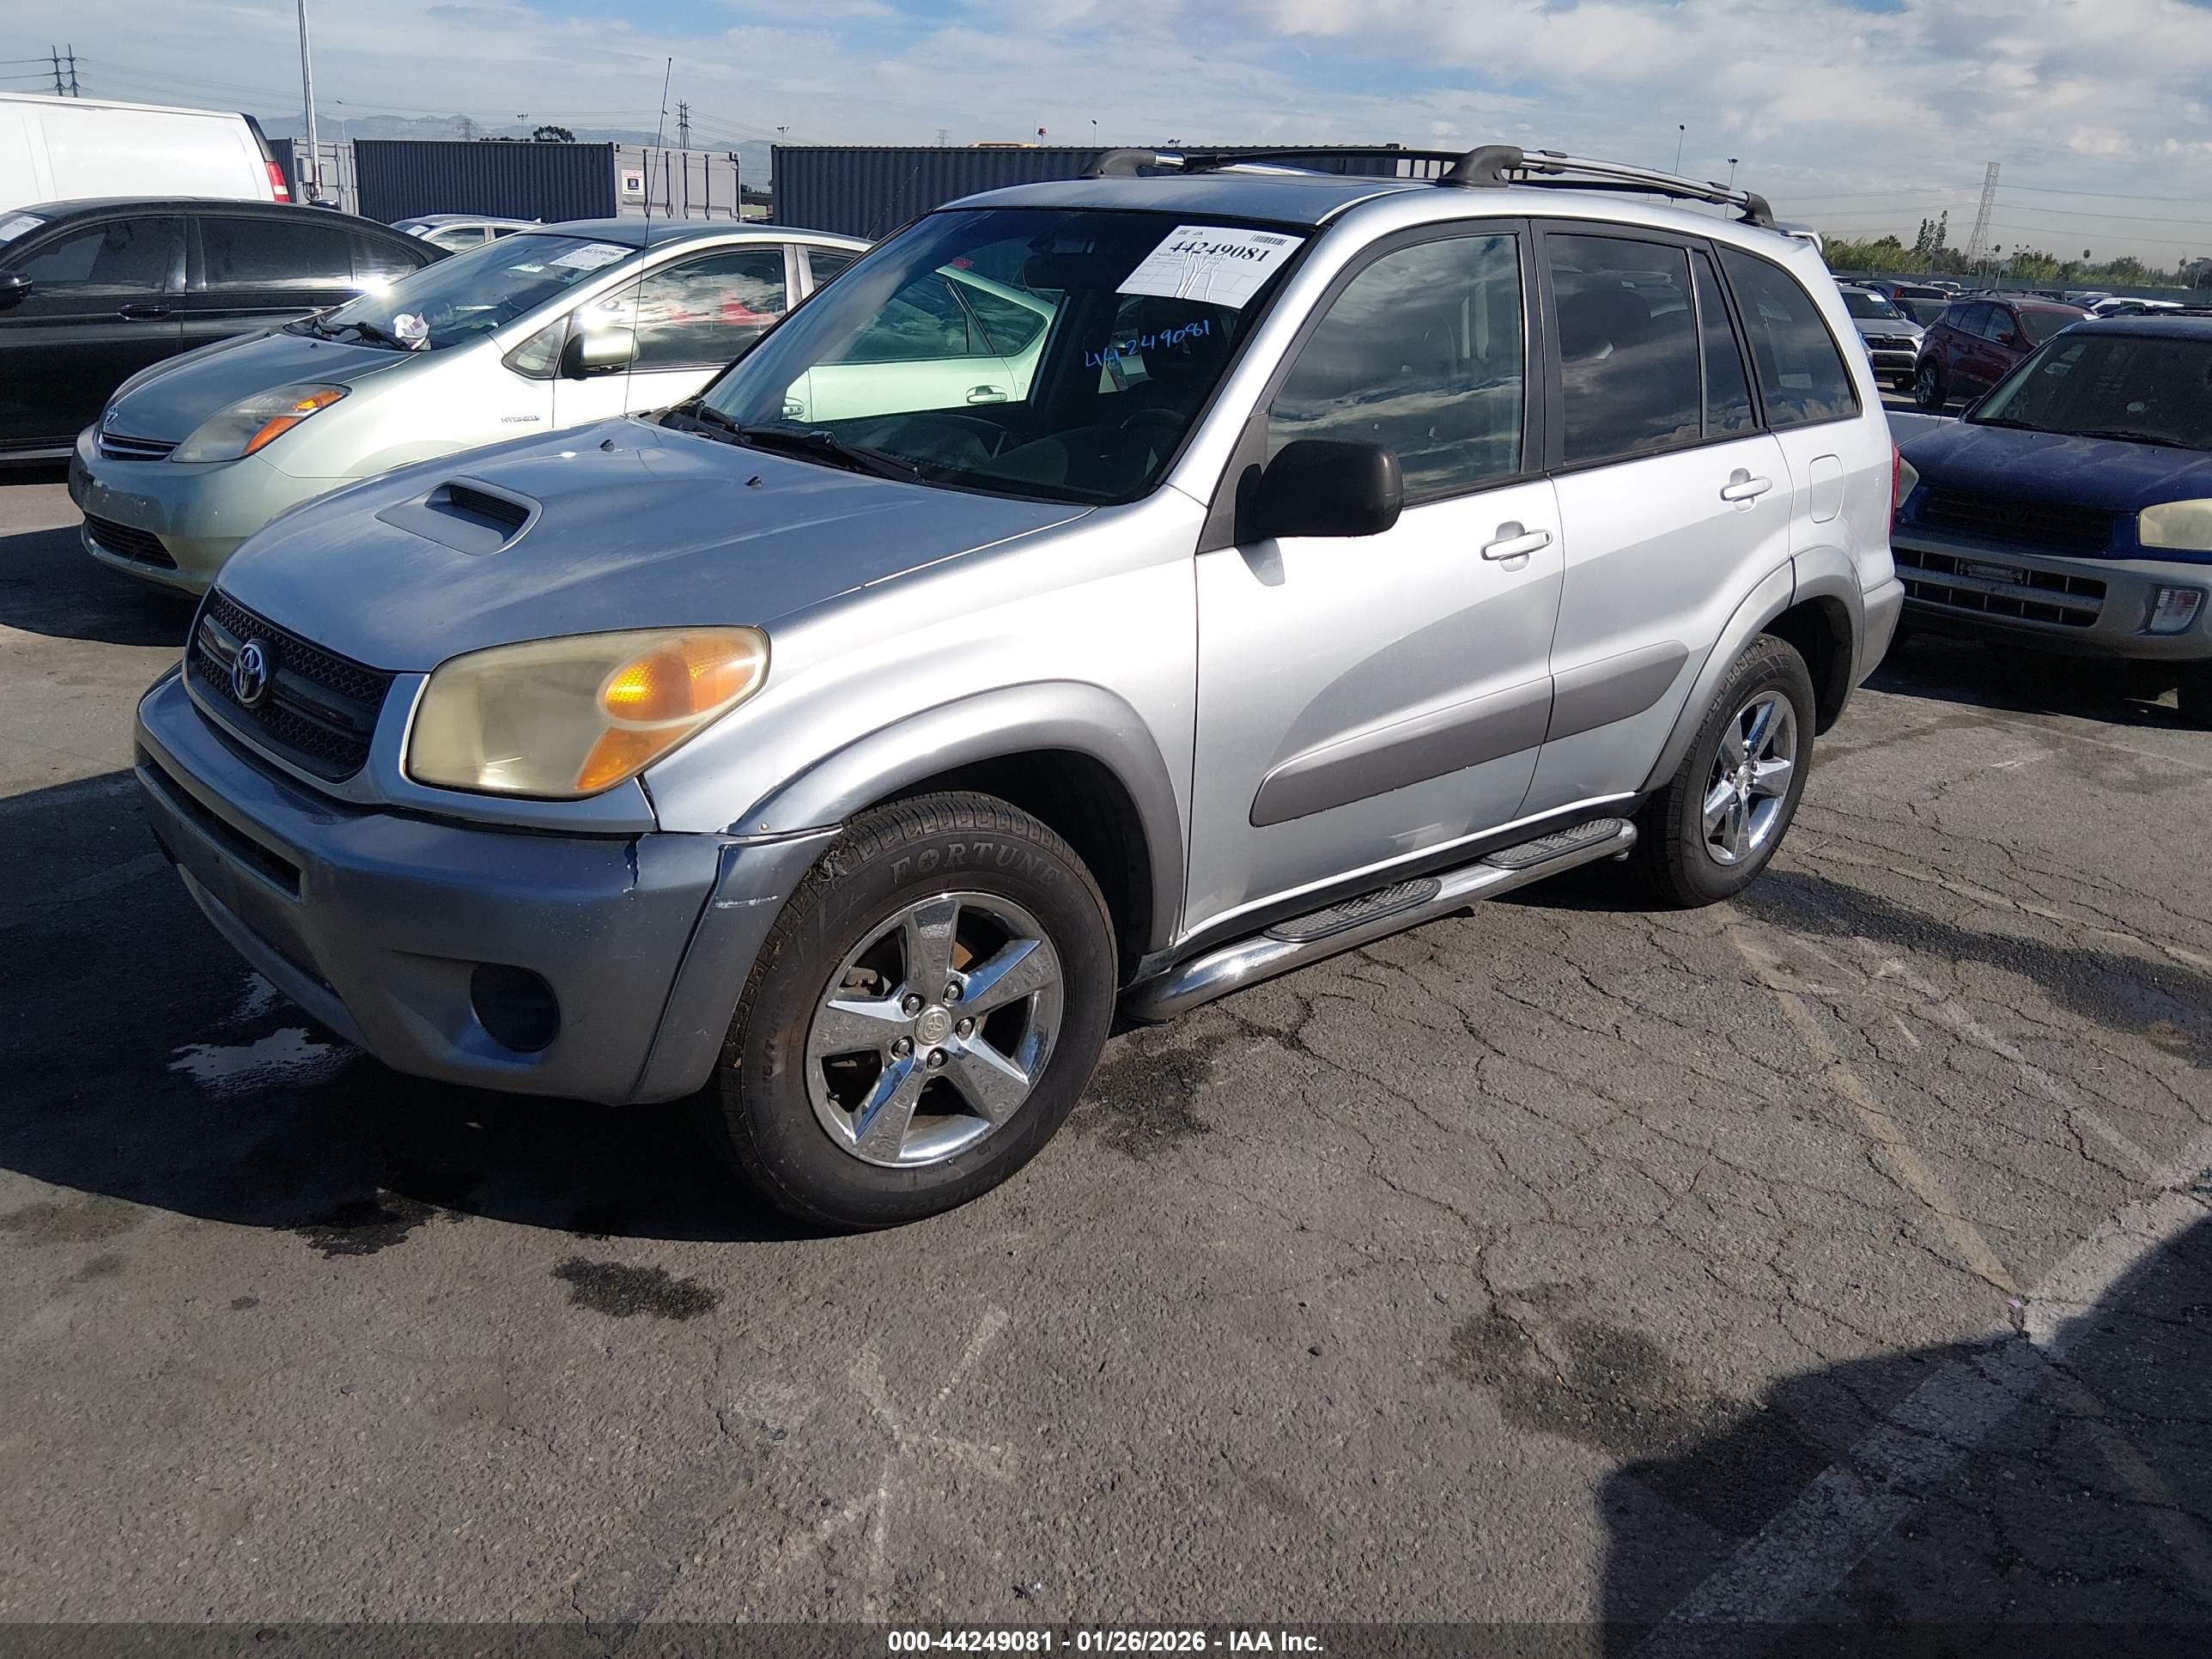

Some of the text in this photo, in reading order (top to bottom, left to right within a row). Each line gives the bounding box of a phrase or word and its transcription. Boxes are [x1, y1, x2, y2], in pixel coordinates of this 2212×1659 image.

[1169, 240, 1272, 262] 44249081
[1085, 319, 1210, 368] 44249081
[890, 842, 1060, 886] FORTUNE
